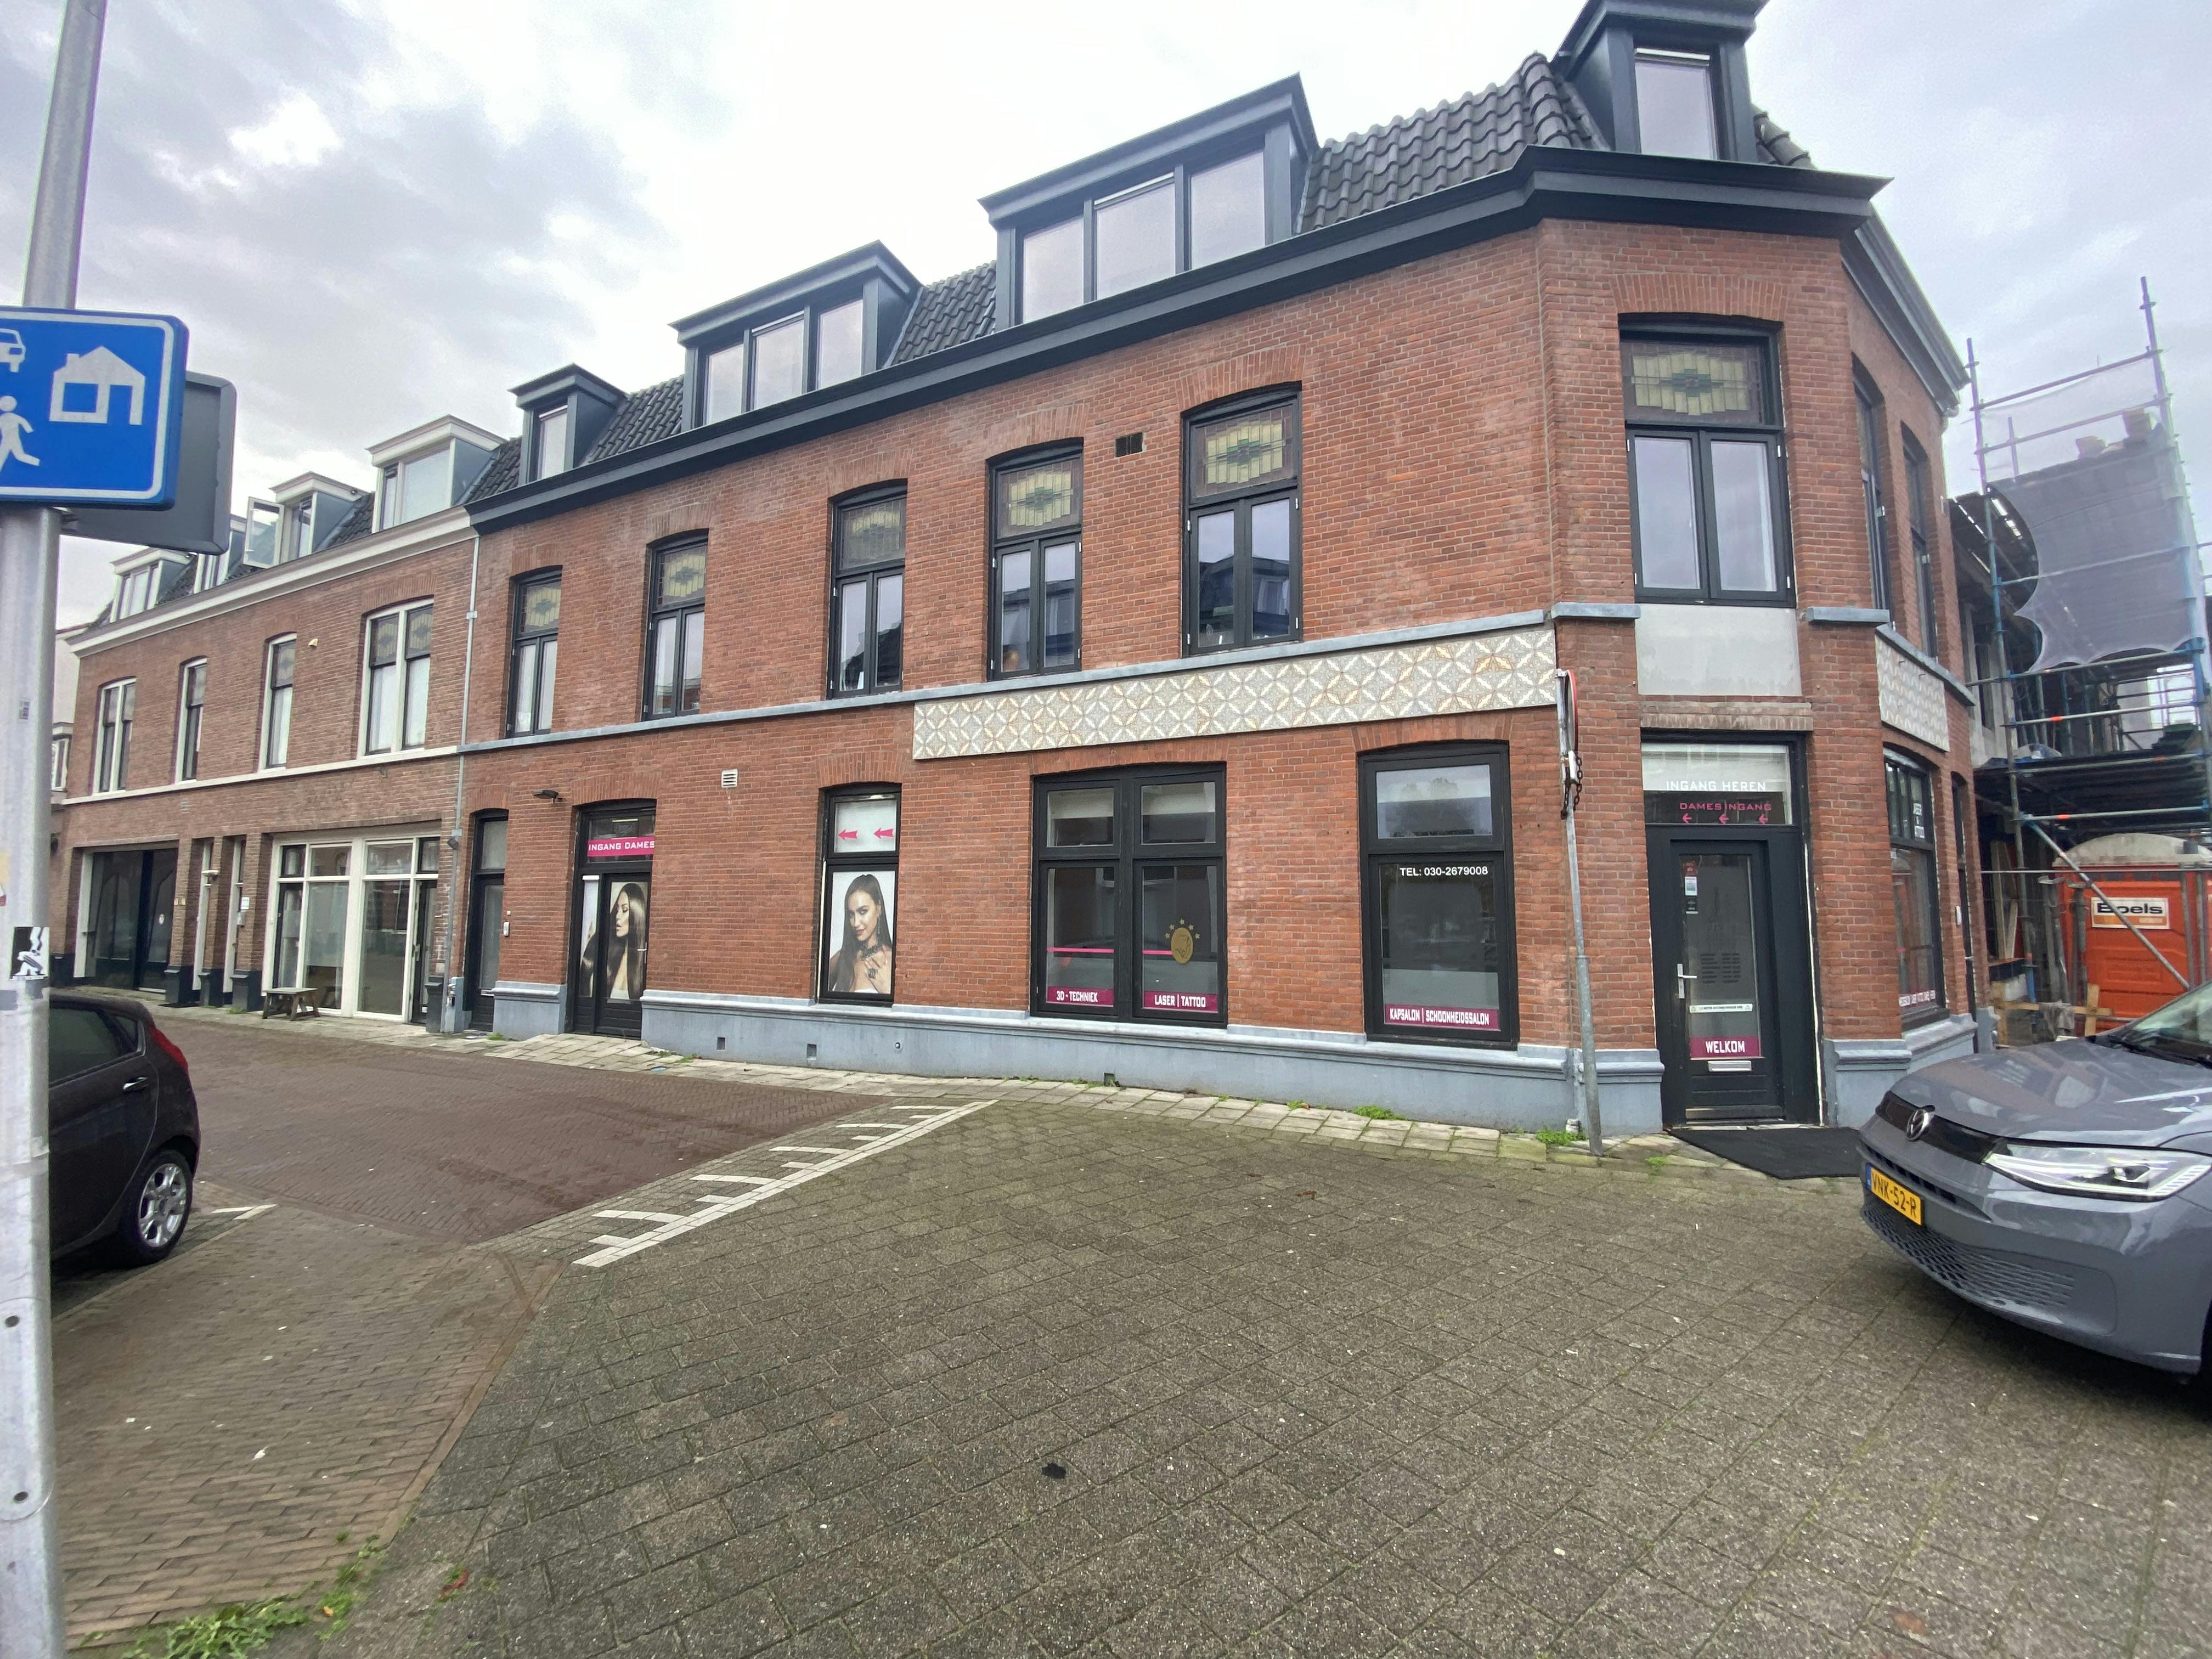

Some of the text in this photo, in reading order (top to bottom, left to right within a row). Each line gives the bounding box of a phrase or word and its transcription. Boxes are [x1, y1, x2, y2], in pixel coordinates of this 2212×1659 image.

[1666, 781, 1766, 792] INGANG HEREN
[1679, 803, 1771, 811] DAMES INGANG
[588, 840, 654, 851] INGANG DAMES
[1400, 866, 1488, 876] TEL: 030-2679008
[1056, 990, 1064, 1001] 3D
[1069, 991, 1098, 1002] TECHNIEK
[1154, 994, 1206, 1008] LASER TATTOO
[1390, 1008, 1489, 1025] KAPSALON SCHOONHEIDSSALON
[1705, 1040, 1745, 1053] WELKOM
[1872, 1173, 1917, 1218] VNK-52-R
